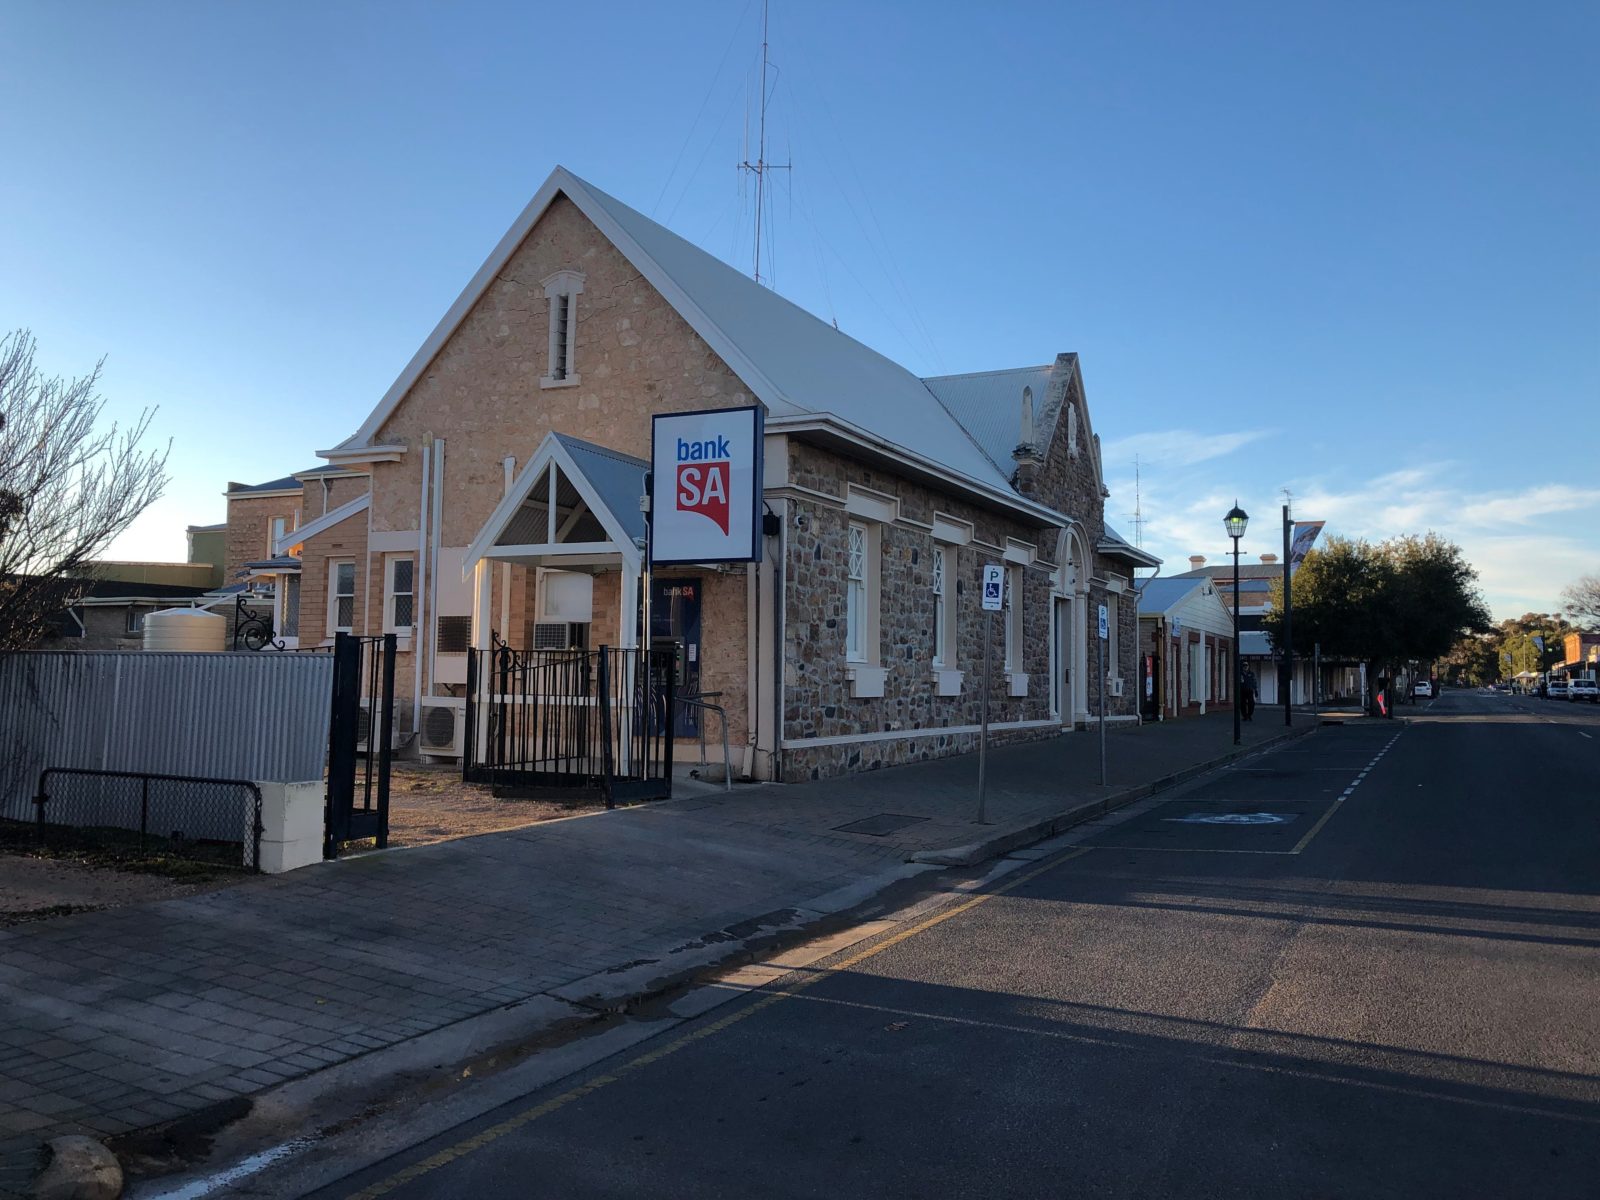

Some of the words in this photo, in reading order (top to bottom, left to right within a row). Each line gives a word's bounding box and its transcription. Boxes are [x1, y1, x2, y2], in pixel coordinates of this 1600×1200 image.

[678, 434, 730, 460] bank
[680, 466, 726, 506] SA
[990, 571, 999, 581] P
